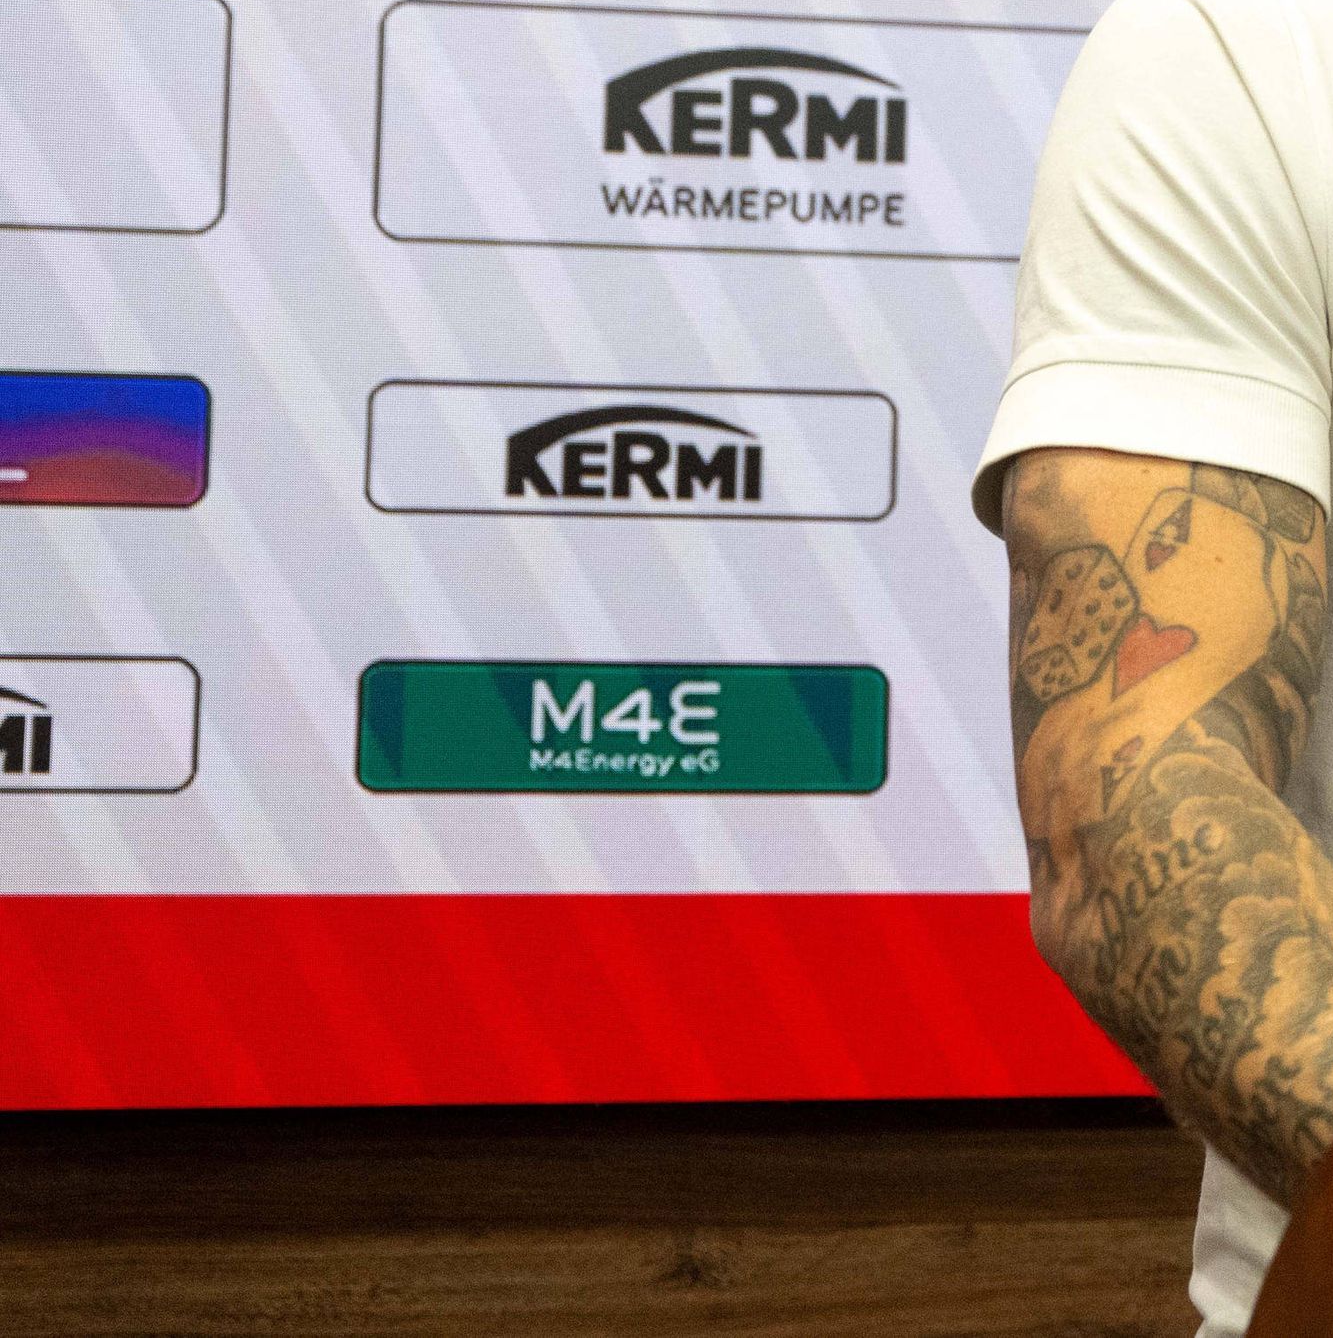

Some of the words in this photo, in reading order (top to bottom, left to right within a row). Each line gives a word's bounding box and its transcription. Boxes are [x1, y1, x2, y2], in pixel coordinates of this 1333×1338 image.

[603, 46, 908, 164] KERMI
[601, 178, 906, 227] WÄRMEPUMPE
[504, 404, 763, 502] KERMI
[530, 747, 675, 777] M4Energy
